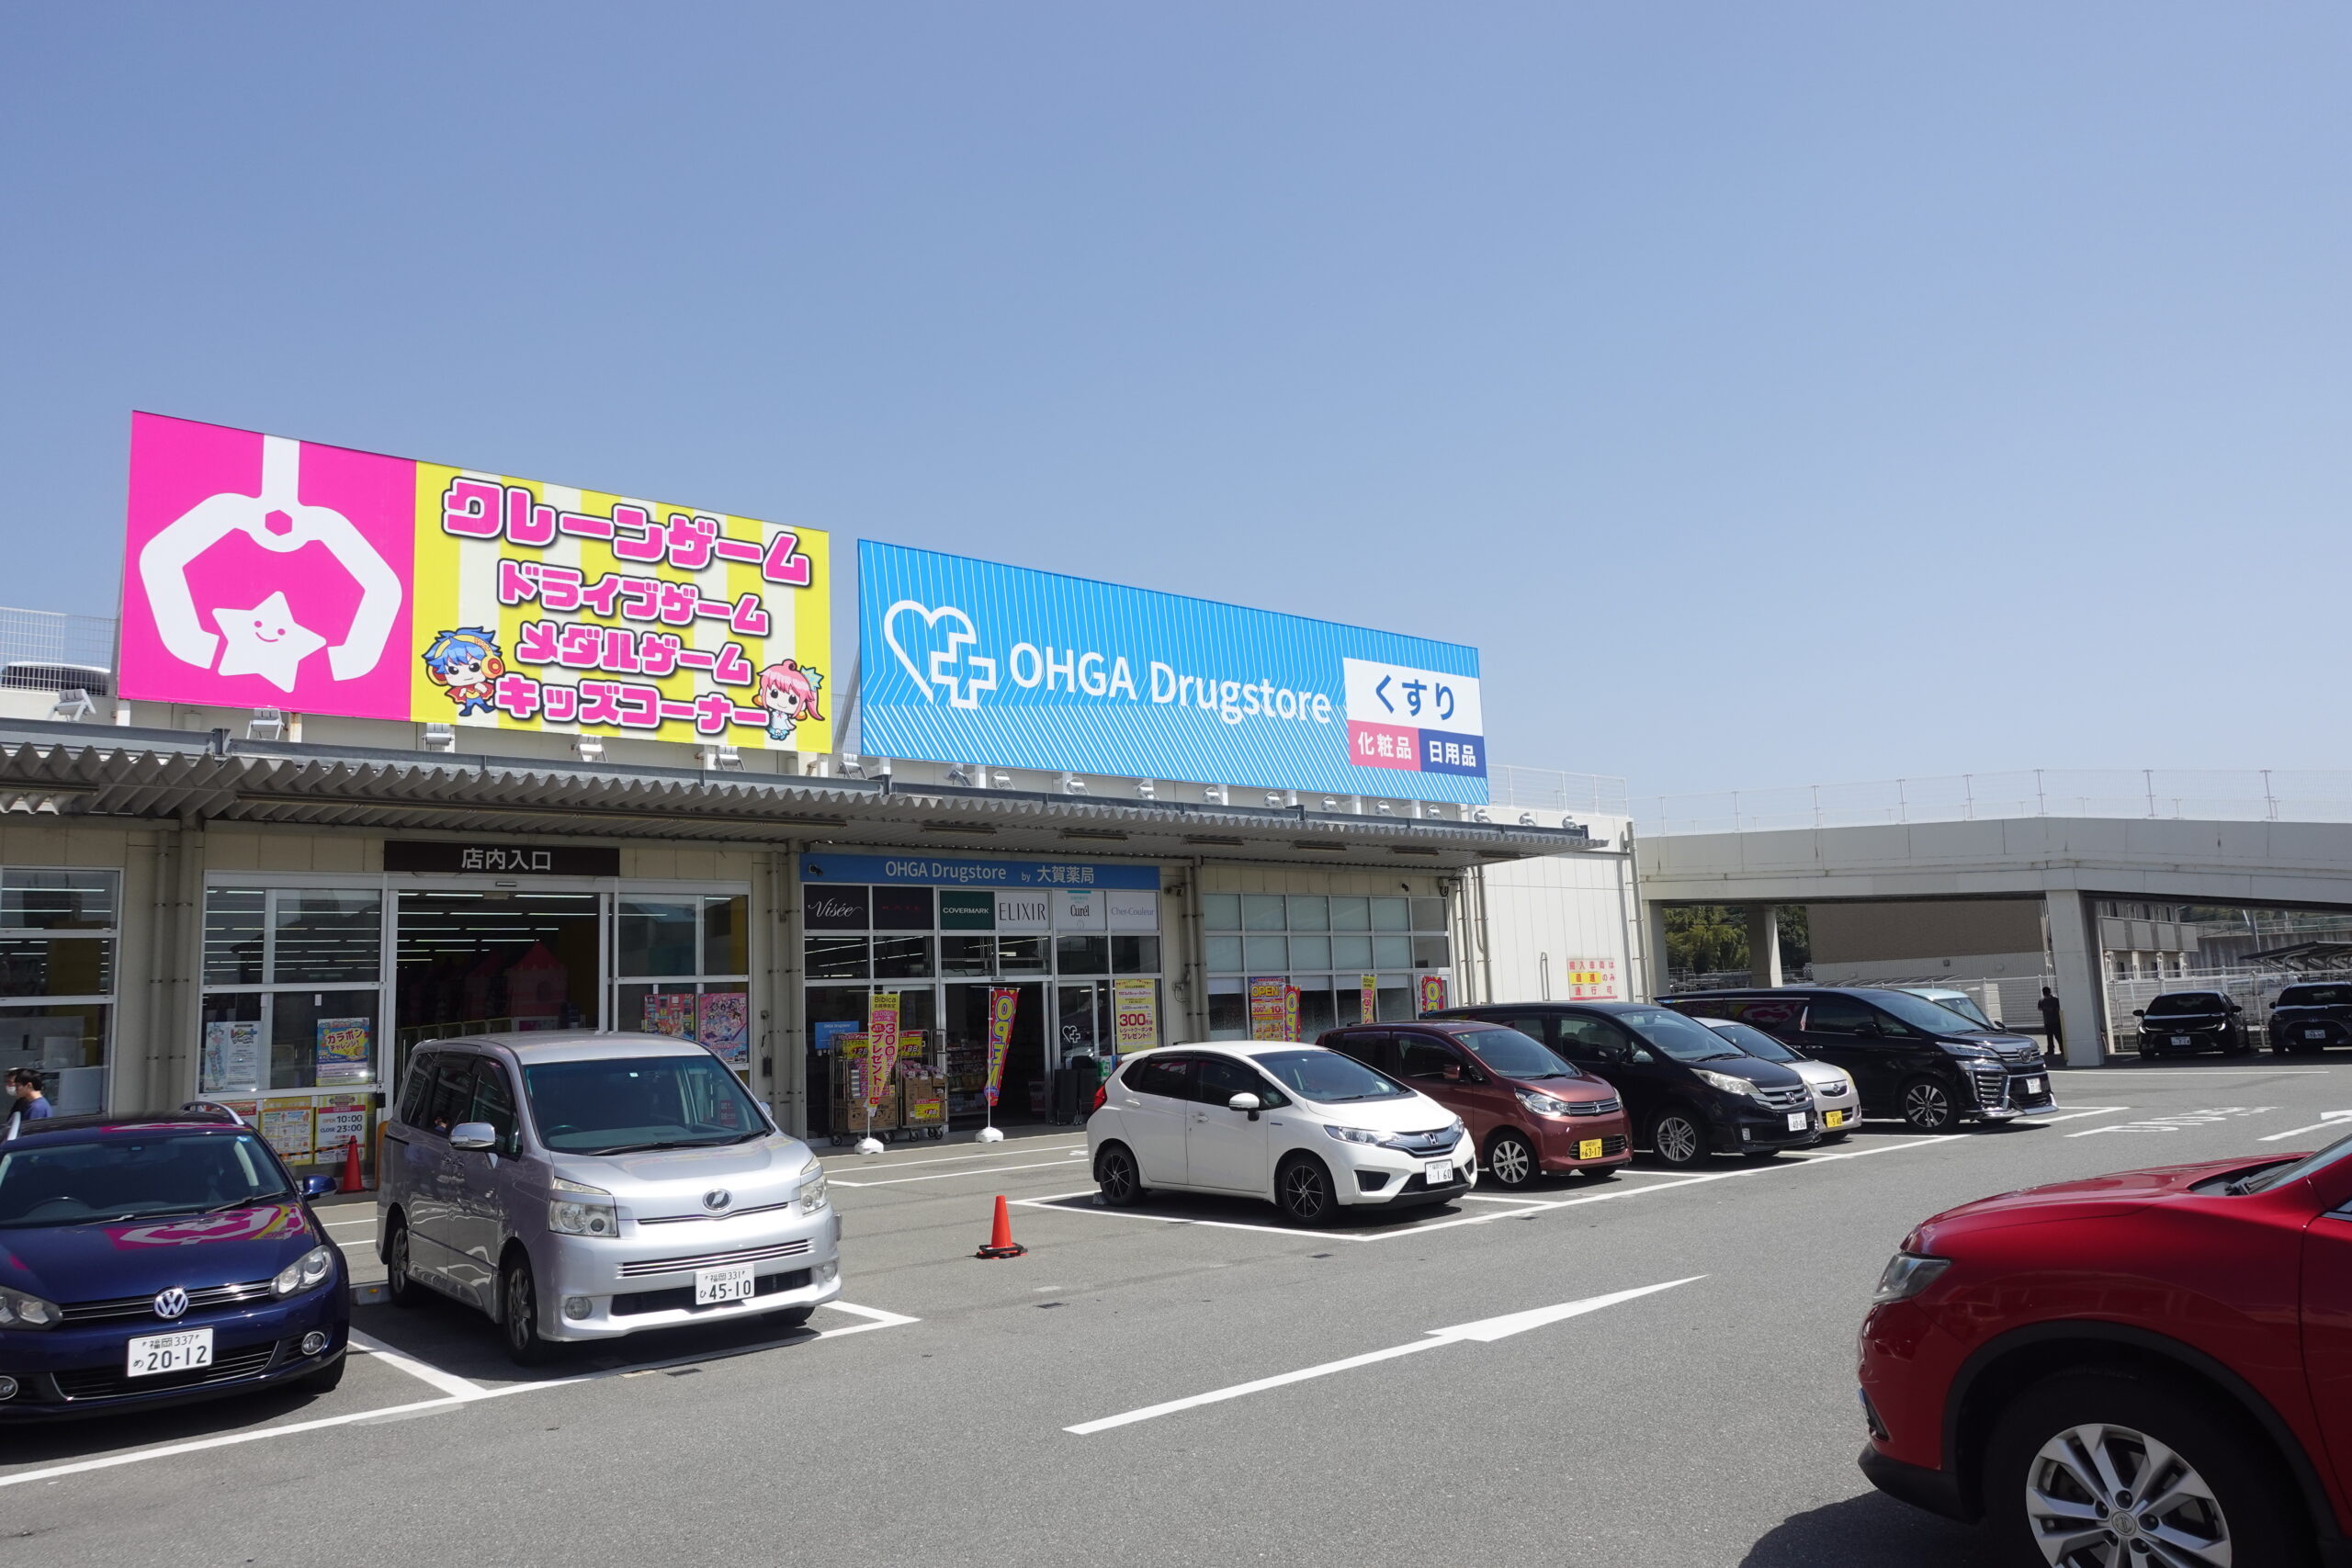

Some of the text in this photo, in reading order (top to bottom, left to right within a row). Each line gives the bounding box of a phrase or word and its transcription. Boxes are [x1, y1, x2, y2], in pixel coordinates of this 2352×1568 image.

[443, 477, 811, 586] クレーンゲーム
[499, 559, 770, 636] ドライブゲーム
[515, 621, 753, 685] メダルゲーム
[1010, 643, 1332, 725] OHGA Drugstore
[494, 671, 770, 735] キッズコーナー
[1375, 674, 1454, 720] くすり
[1358, 731, 1412, 760] 化粧品
[1429, 740, 1476, 767] 日用品
[462, 847, 551, 871] 店内入口
[885, 861, 1094, 884] OHGA Drugstore by 大賀薬局
[808, 897, 864, 918] Visée
[999, 902, 1046, 921] ELIXIR
[1070, 904, 1090, 917] Curél
[1251, 986, 1280, 997] OPEN
[1286, 991, 1297, 1042] OPE
[327, 1028, 363, 1044] ガラポン
[336, 1114, 363, 1122] 10:00
[336, 1123, 363, 1133] 23:00
[709, 1280, 751, 1300] 45-10
[150, 1335, 194, 1349] 福岡 337
[133, 1345, 208, 1371] の 20-12
